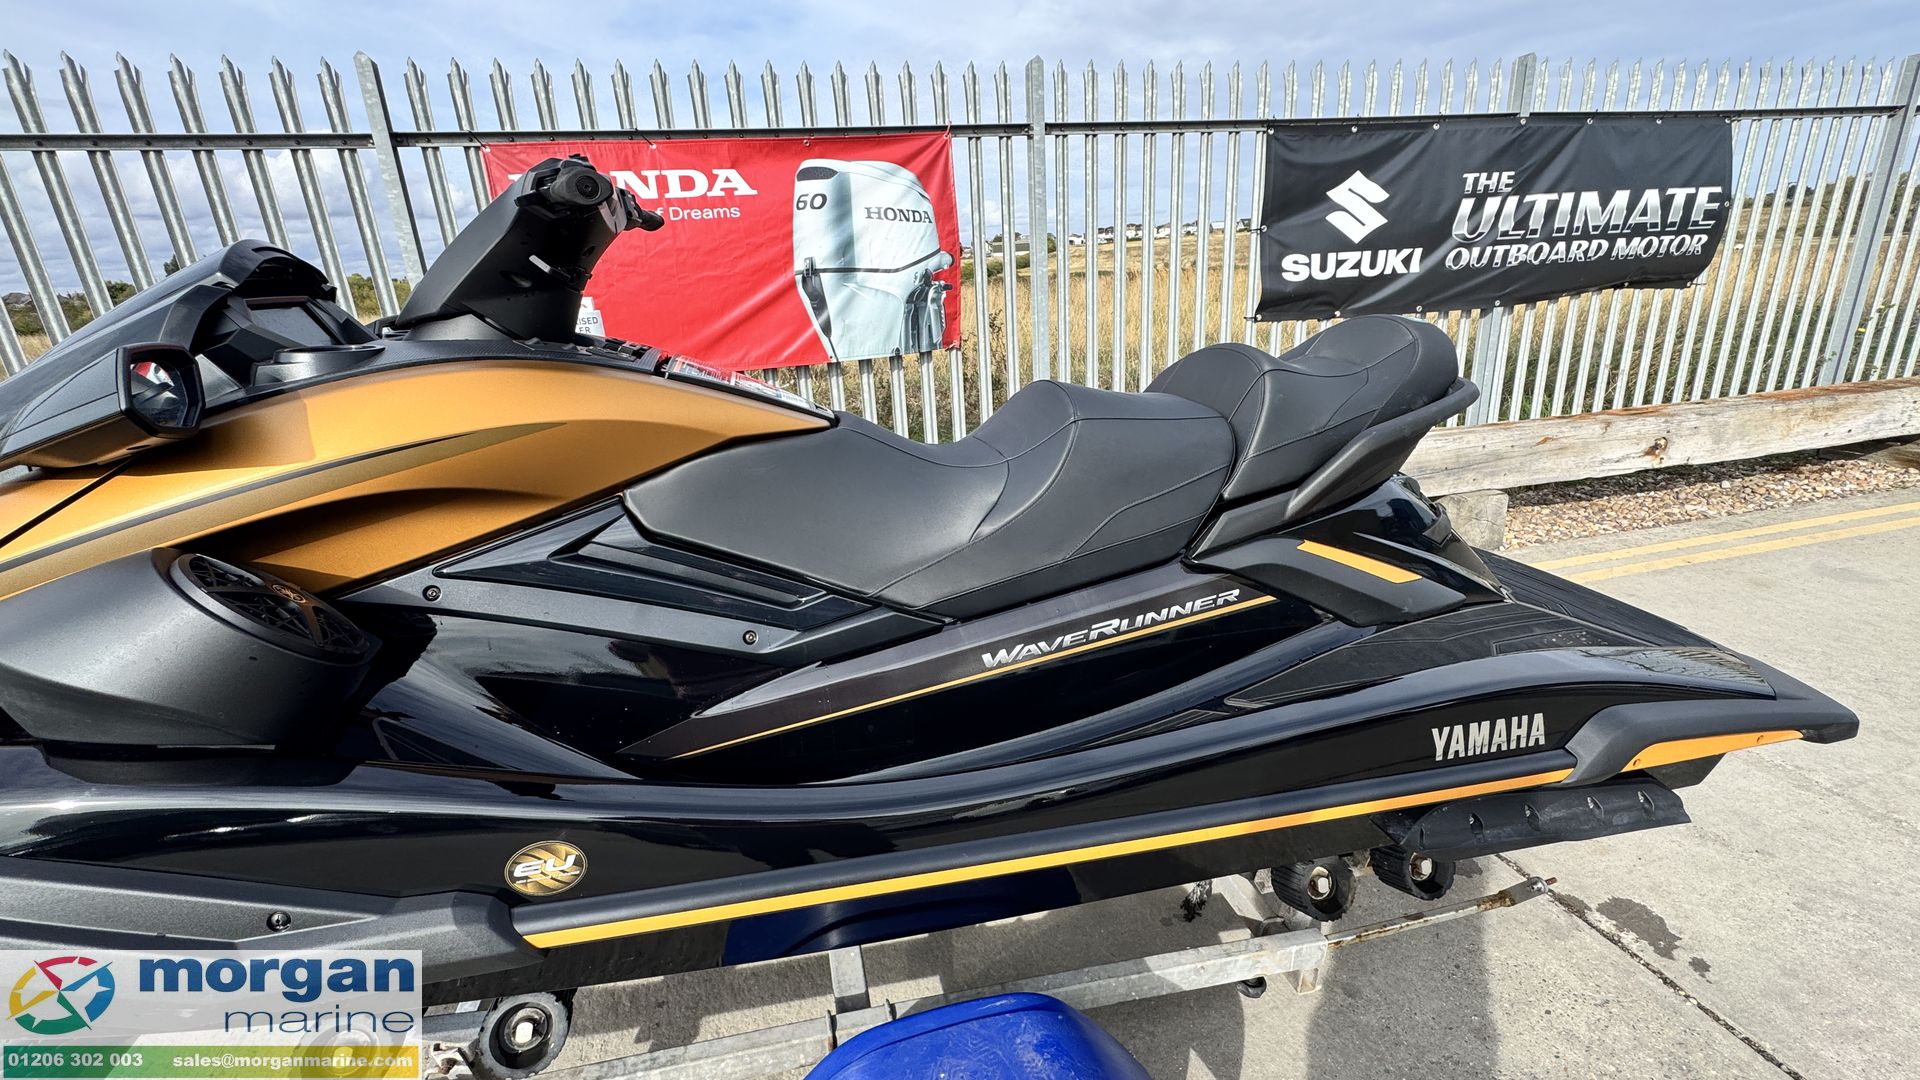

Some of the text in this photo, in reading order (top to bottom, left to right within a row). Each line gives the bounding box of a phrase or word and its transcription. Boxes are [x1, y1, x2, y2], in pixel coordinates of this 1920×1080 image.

[508, 168, 758, 199] NDA
[1462, 171, 1516, 194] THE
[668, 206, 741, 221] Dreams
[796, 193, 828, 211] 60
[864, 206, 933, 224] HONDA
[1450, 186, 1723, 244] ULTIMATE
[1281, 247, 1423, 282] SUZUKI
[1445, 233, 1709, 271] OUTBOARD MOTOR
[1431, 712, 1546, 762] YAMAHA
